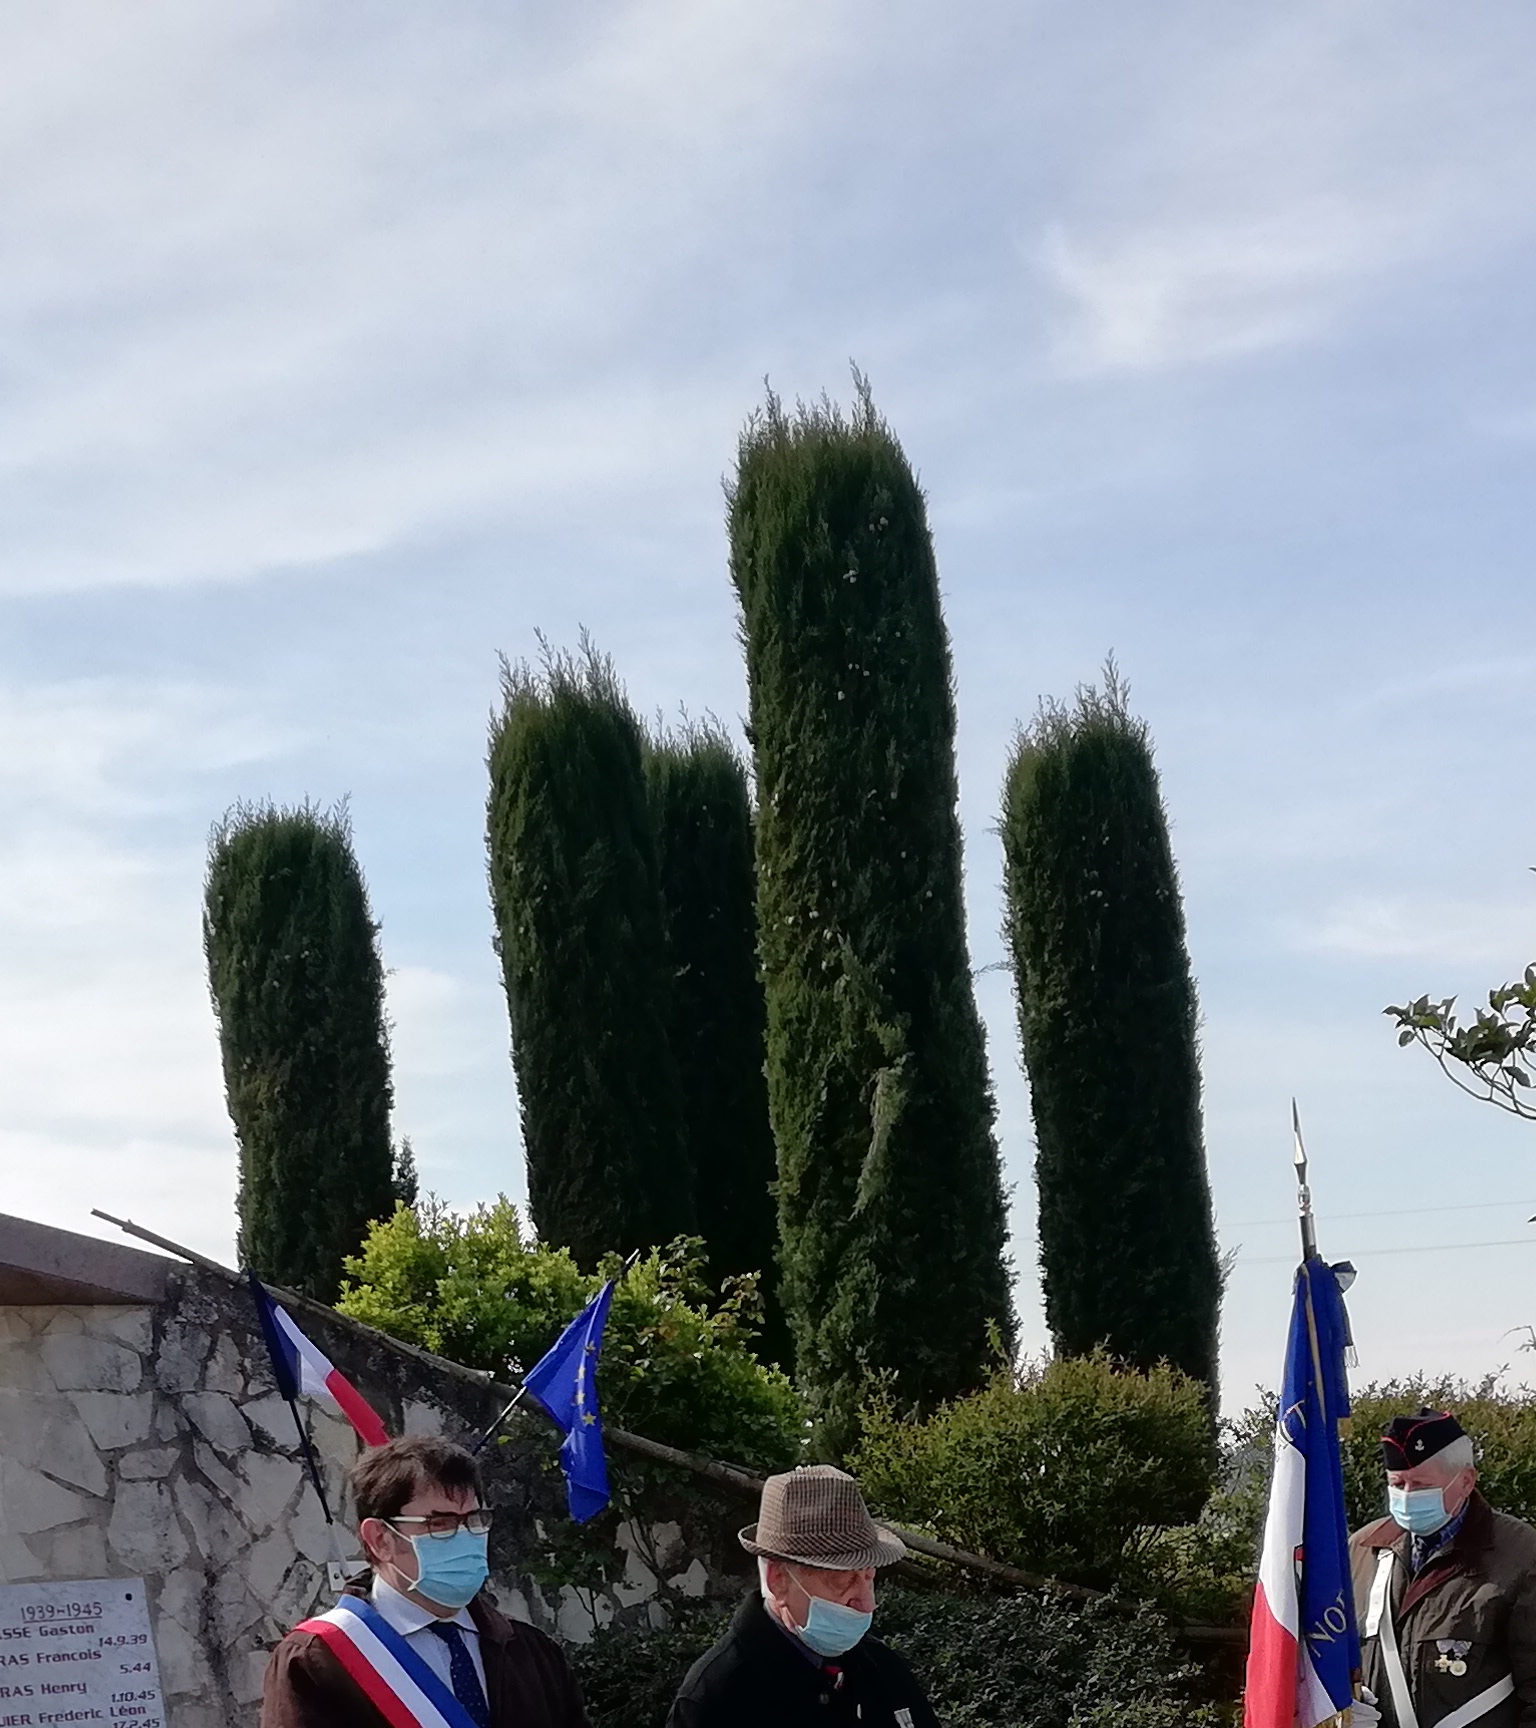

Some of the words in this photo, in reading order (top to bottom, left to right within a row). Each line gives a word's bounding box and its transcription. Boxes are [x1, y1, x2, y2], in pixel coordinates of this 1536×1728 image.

[21, 1601, 103, 1623] 1939-1945
[38, 1623, 95, 1637] Gaston
[98, 1633, 148, 1648] 14.9.39
[119, 1661, 152, 1675] 5.44
[40, 1681, 88, 1696] Henry
[111, 1689, 156, 1703] 1.10.45
[109, 1704, 147, 1718] Léon
